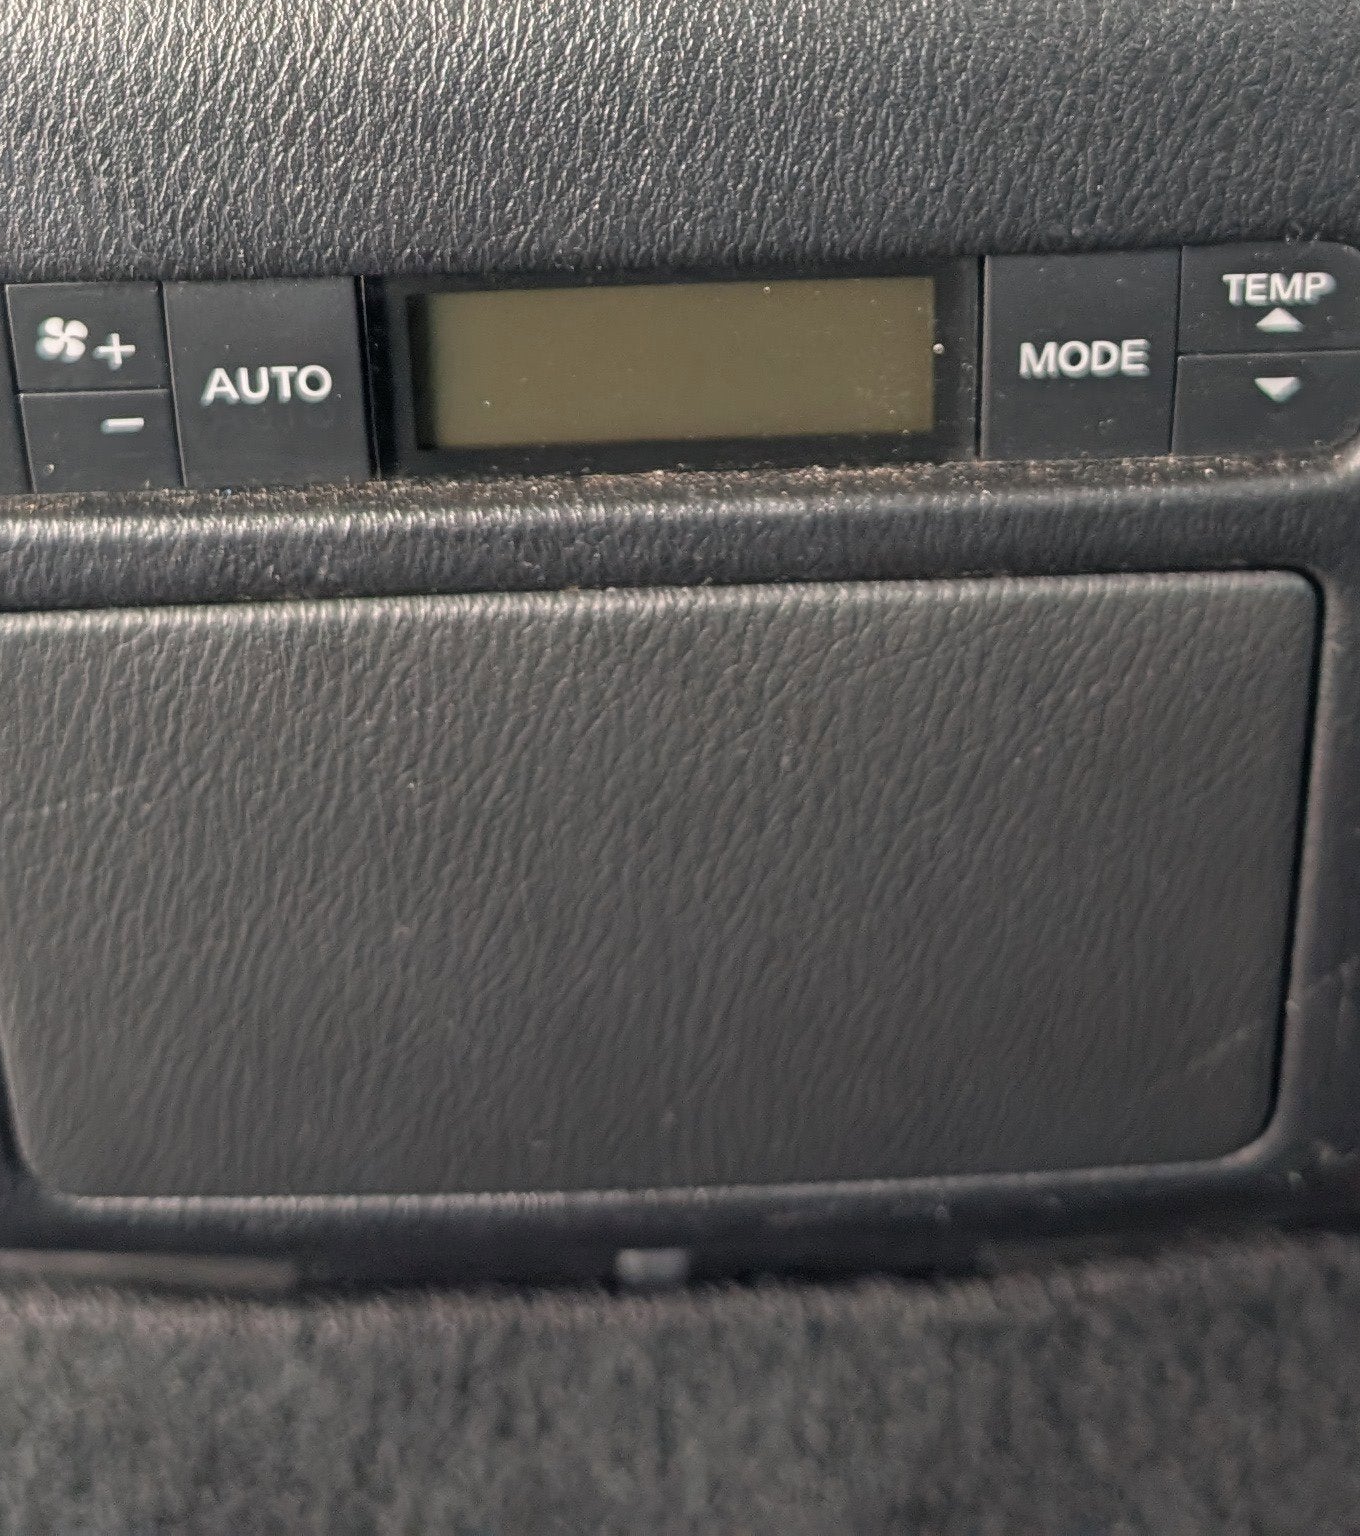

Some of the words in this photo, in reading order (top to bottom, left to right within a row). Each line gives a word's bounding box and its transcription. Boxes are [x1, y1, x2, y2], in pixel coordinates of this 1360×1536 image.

[1221, 271, 1337, 306] TEMP
[1018, 337, 1151, 380] MODE
[200, 364, 333, 407] AUTO
